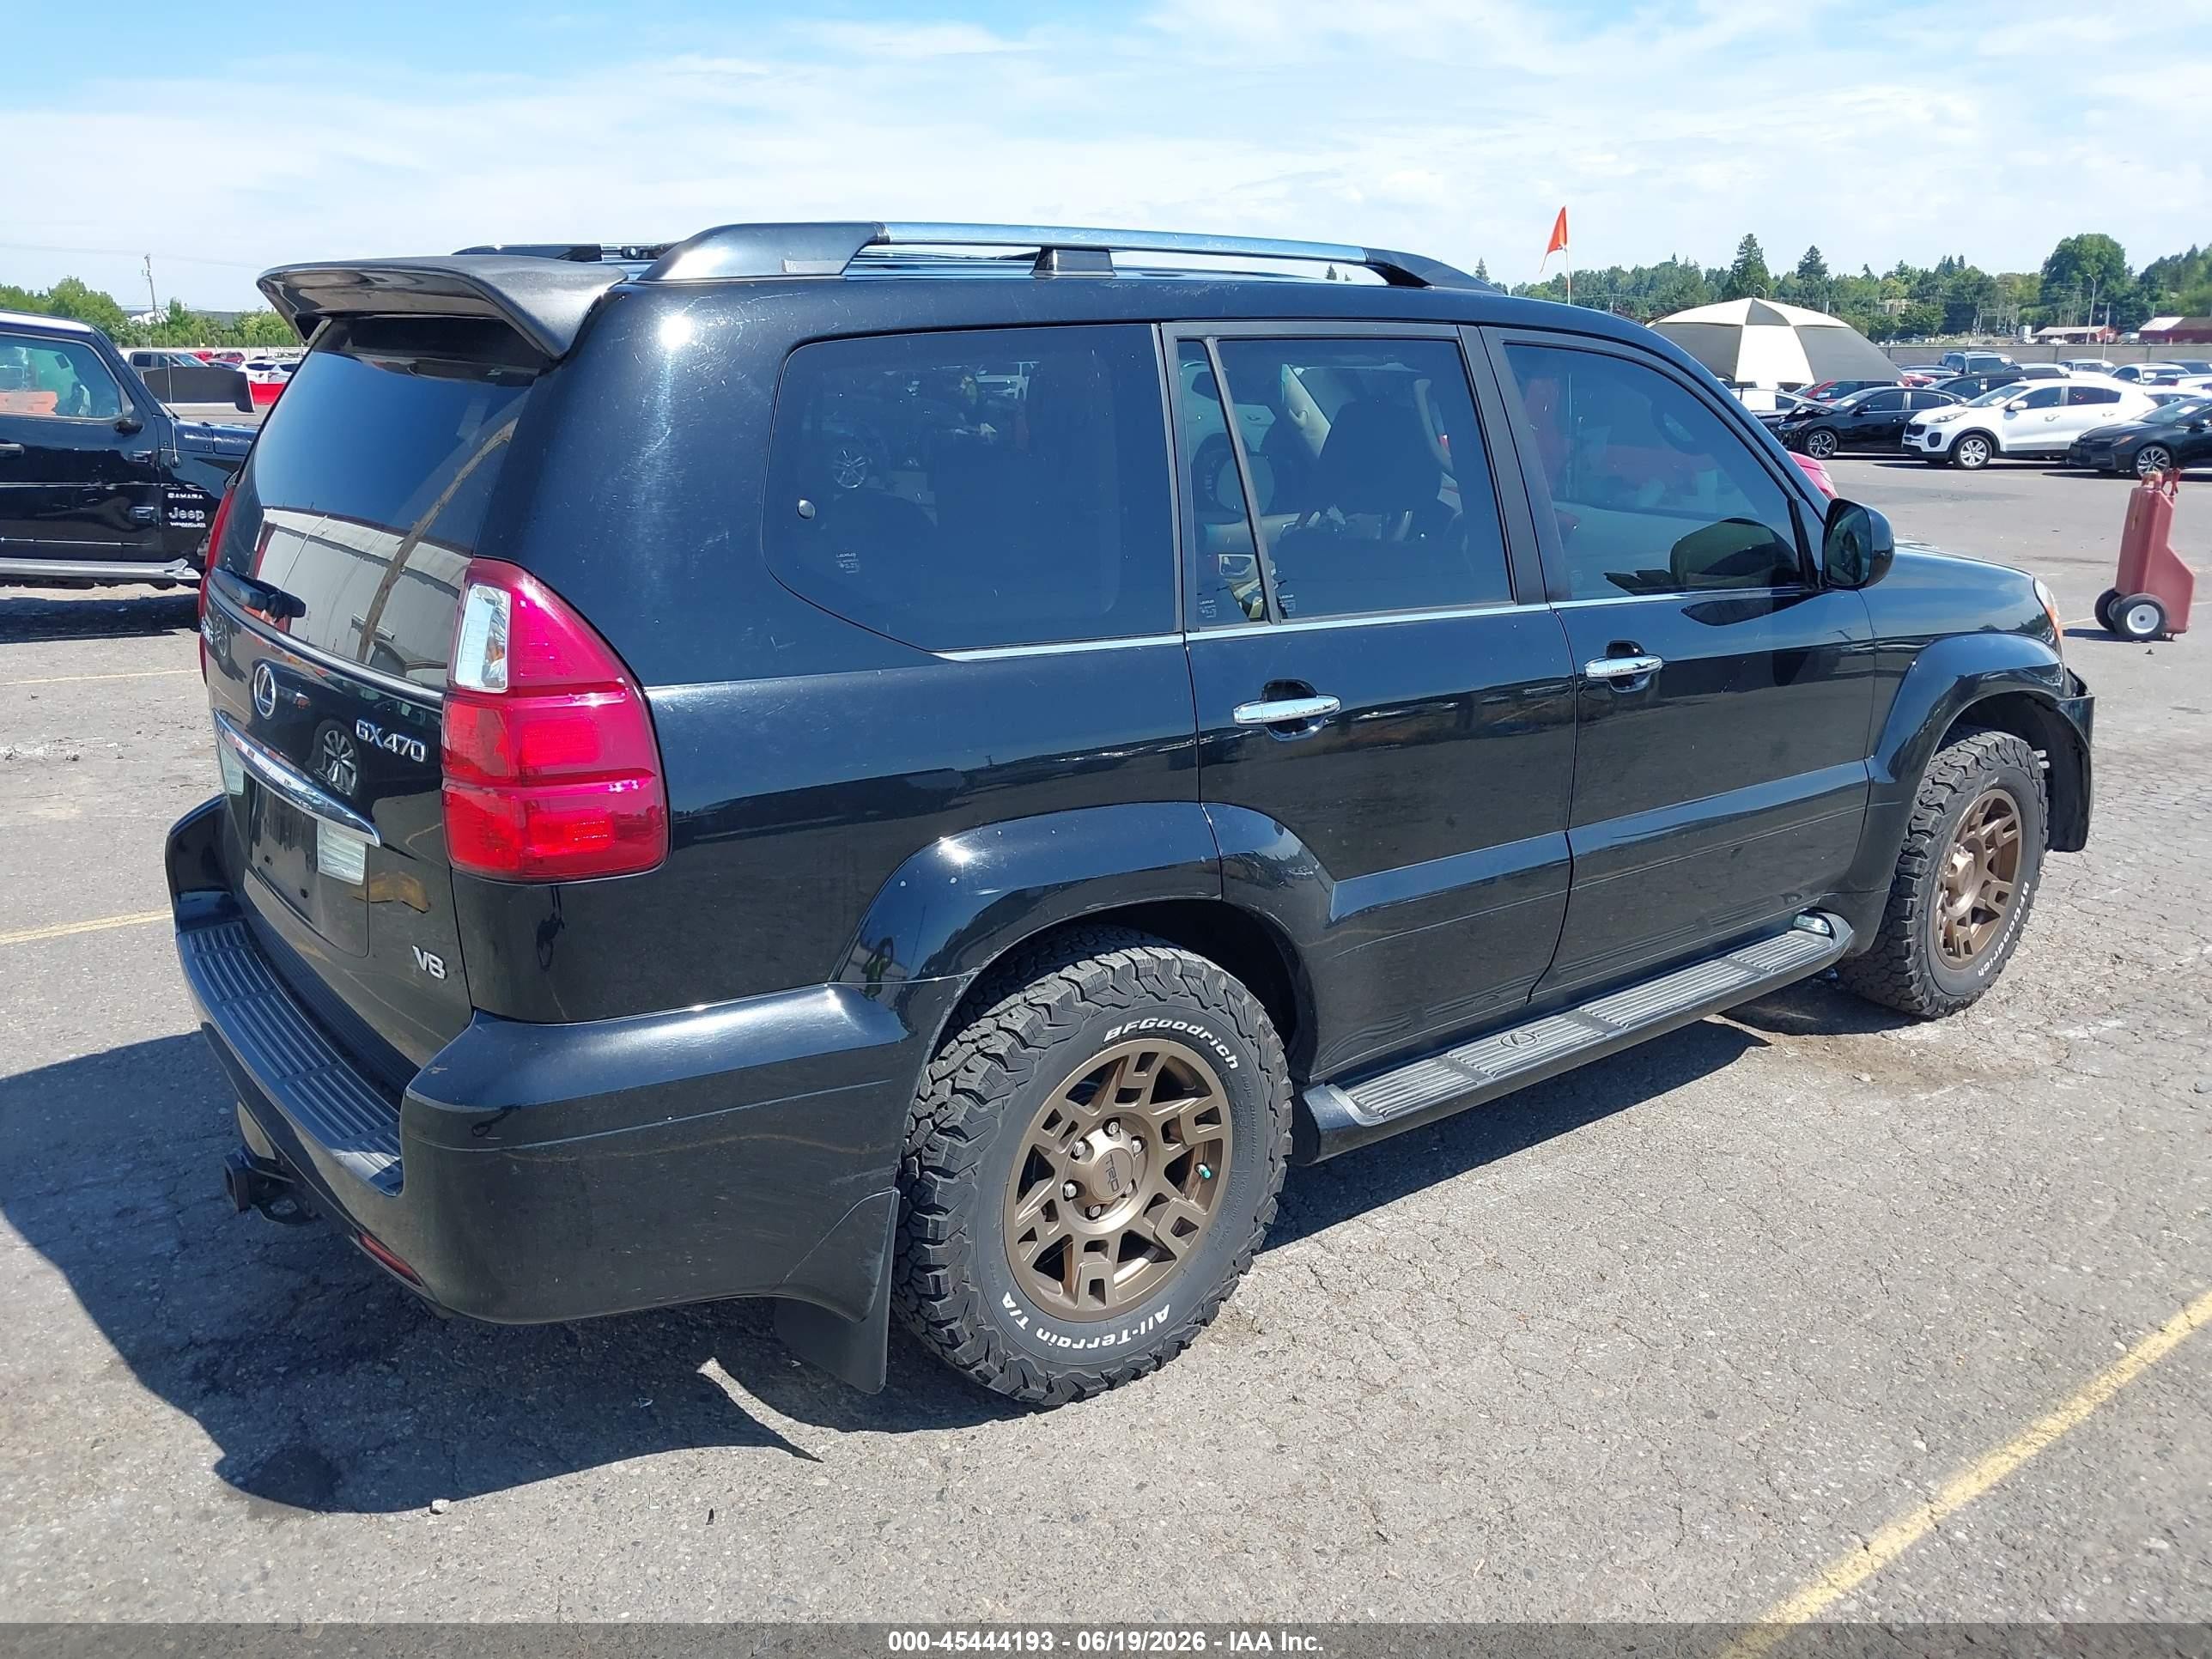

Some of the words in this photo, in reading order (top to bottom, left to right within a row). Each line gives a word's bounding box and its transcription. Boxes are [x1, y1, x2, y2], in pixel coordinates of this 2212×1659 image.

[168, 507, 205, 522] Jeep
[1978, 882, 2030, 977] BFGoodrich
[411, 945, 447, 980] V8
[1103, 1017, 1240, 1071] BFGoodrich
[1105, 1153, 1120, 1193] TRD
[1001, 1291, 1030, 1330] T/A
